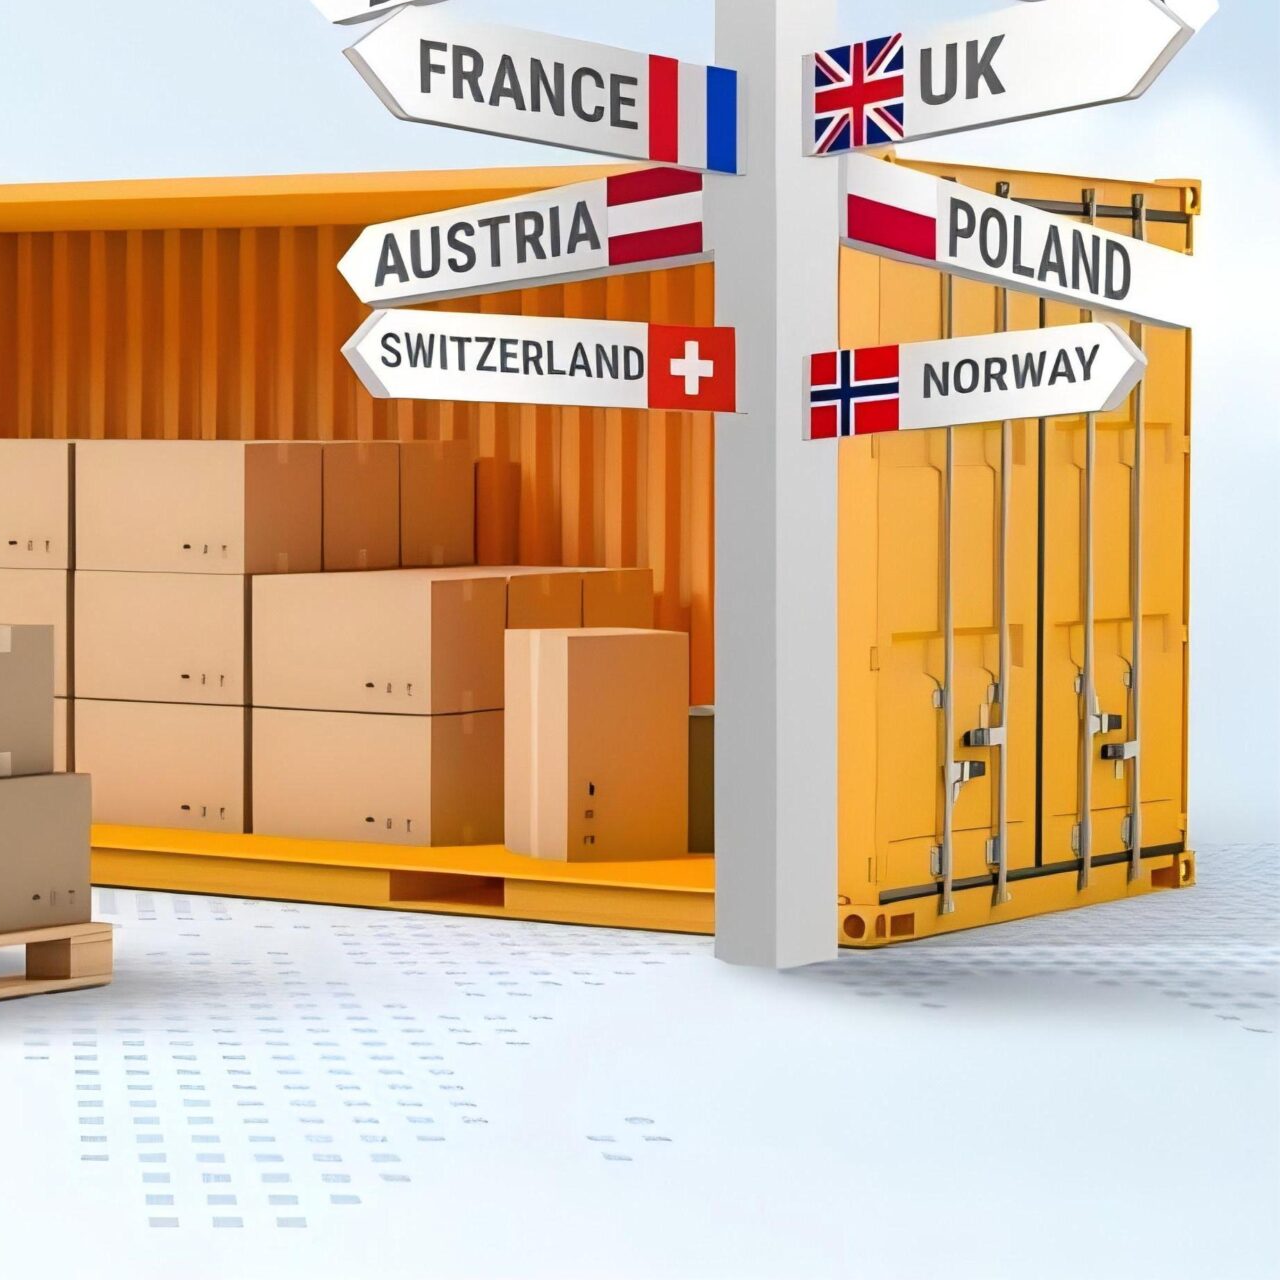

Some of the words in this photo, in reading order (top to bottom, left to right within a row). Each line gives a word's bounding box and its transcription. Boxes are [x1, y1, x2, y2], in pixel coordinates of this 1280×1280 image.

[420, 39, 639, 130] FRANCE
[919, 34, 1006, 105] UK
[375, 200, 601, 287] AUSTRIA
[949, 196, 1131, 300] POLAND
[381, 332, 645, 380] SWITZERLAND
[923, 344, 1100, 398] NORWAY
